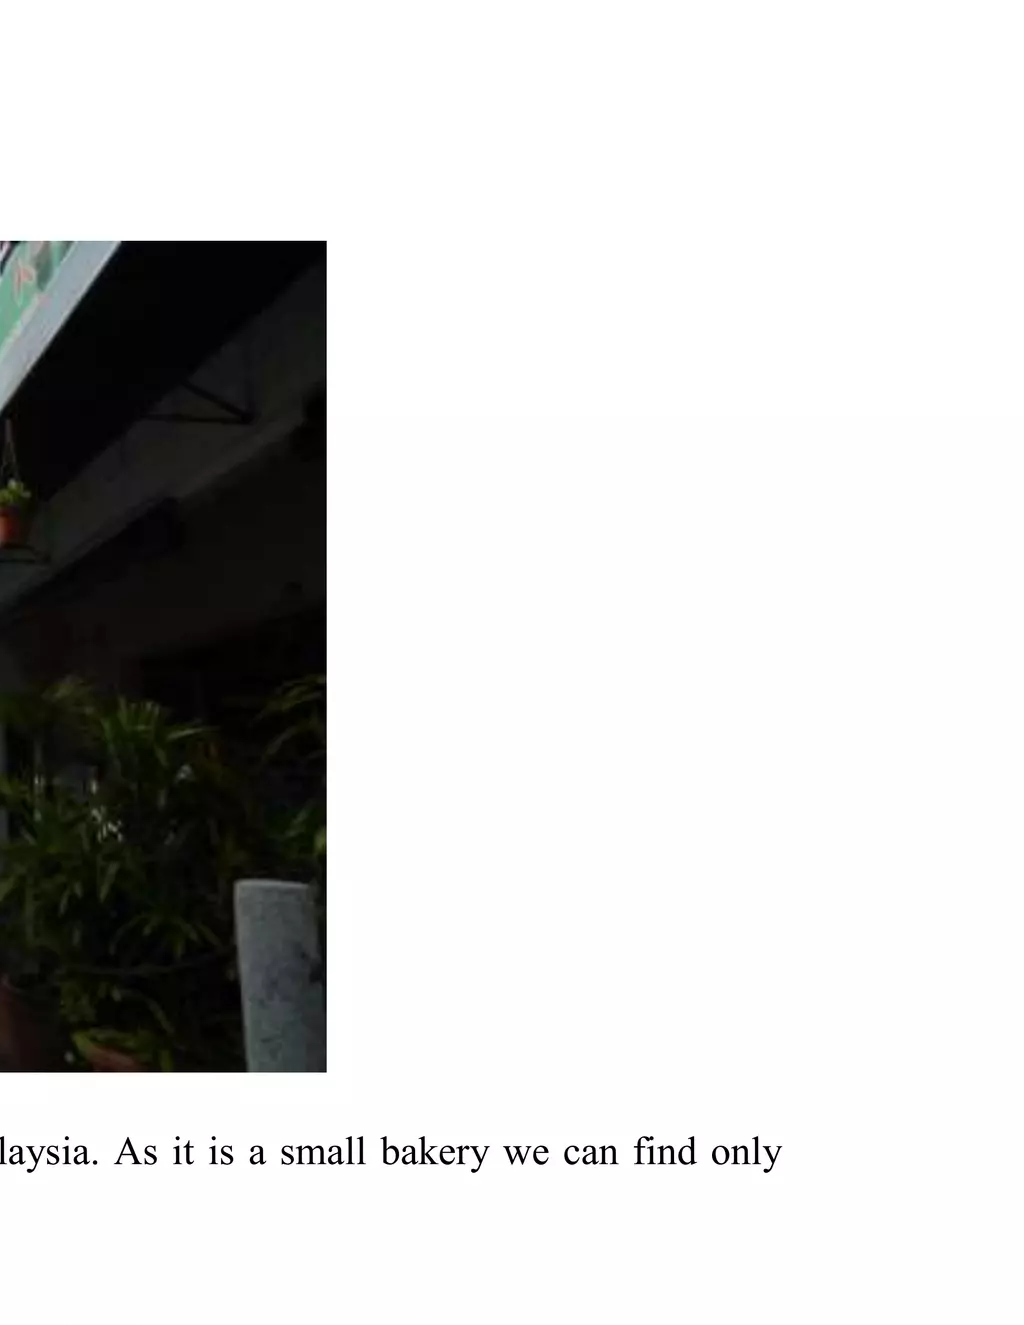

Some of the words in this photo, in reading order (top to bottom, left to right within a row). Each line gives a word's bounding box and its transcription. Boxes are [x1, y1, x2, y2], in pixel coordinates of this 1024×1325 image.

[114, 1137, 157, 1165] As
[173, 1136, 194, 1165] it
[209, 1136, 233, 1165] is
[250, 1145, 266, 1165] a
[281, 1136, 366, 1165] small
[380, 1136, 490, 1173] bakery
[503, 1145, 549, 1165] we
[564, 1145, 618, 1165] can
[634, 1136, 697, 1165] find
[712, 1136, 782, 1173] only
